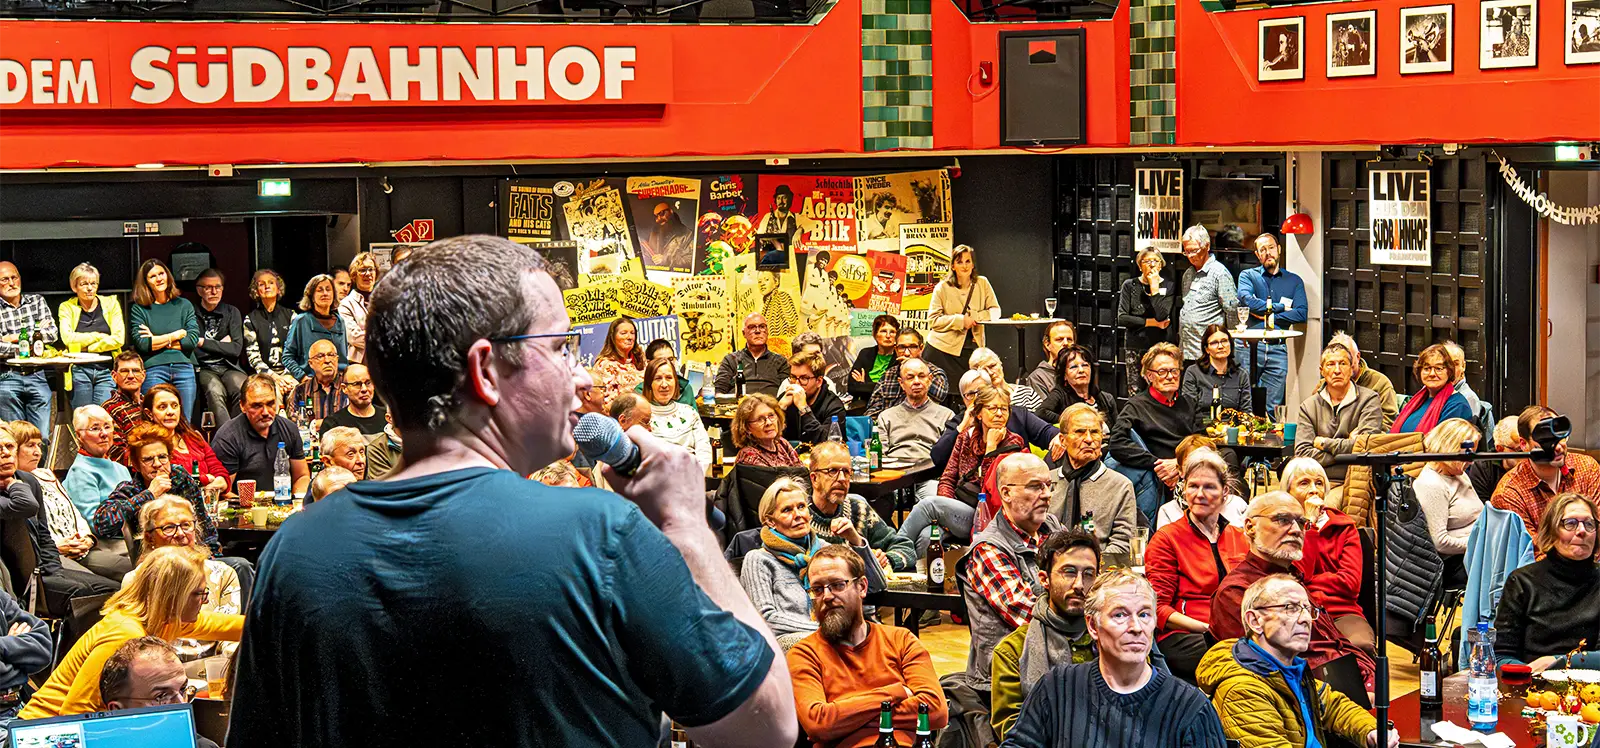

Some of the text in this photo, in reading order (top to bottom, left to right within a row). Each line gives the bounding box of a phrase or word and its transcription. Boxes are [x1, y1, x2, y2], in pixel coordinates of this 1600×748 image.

[0, 45, 637, 104] DEM SÜDBAHNHOF
[710, 180, 737, 191] Chris
[865, 176, 886, 184] VINCE
[1138, 170, 1181, 196] LIVE
[1373, 172, 1428, 201] LIVE
[635, 184, 691, 200] SUPERCHARGE
[710, 190, 743, 200] Barber
[509, 192, 554, 220] FATS
[800, 196, 854, 218] Acker
[1139, 196, 1181, 210] AUS DEM
[1401, 202, 1428, 217] DEM
[508, 219, 551, 229] AND HIS CATS
[809, 220, 850, 241] Bilk
[1137, 211, 1181, 240] SÜDBAHNHOF
[1373, 218, 1428, 251] SÜDBAHNHOF
[580, 287, 605, 304] DIXIE
[634, 283, 659, 299] DIXIE
[583, 301, 610, 313] SWING
[631, 294, 660, 312] SWING
[577, 309, 617, 322] SCHLACHTHOF
